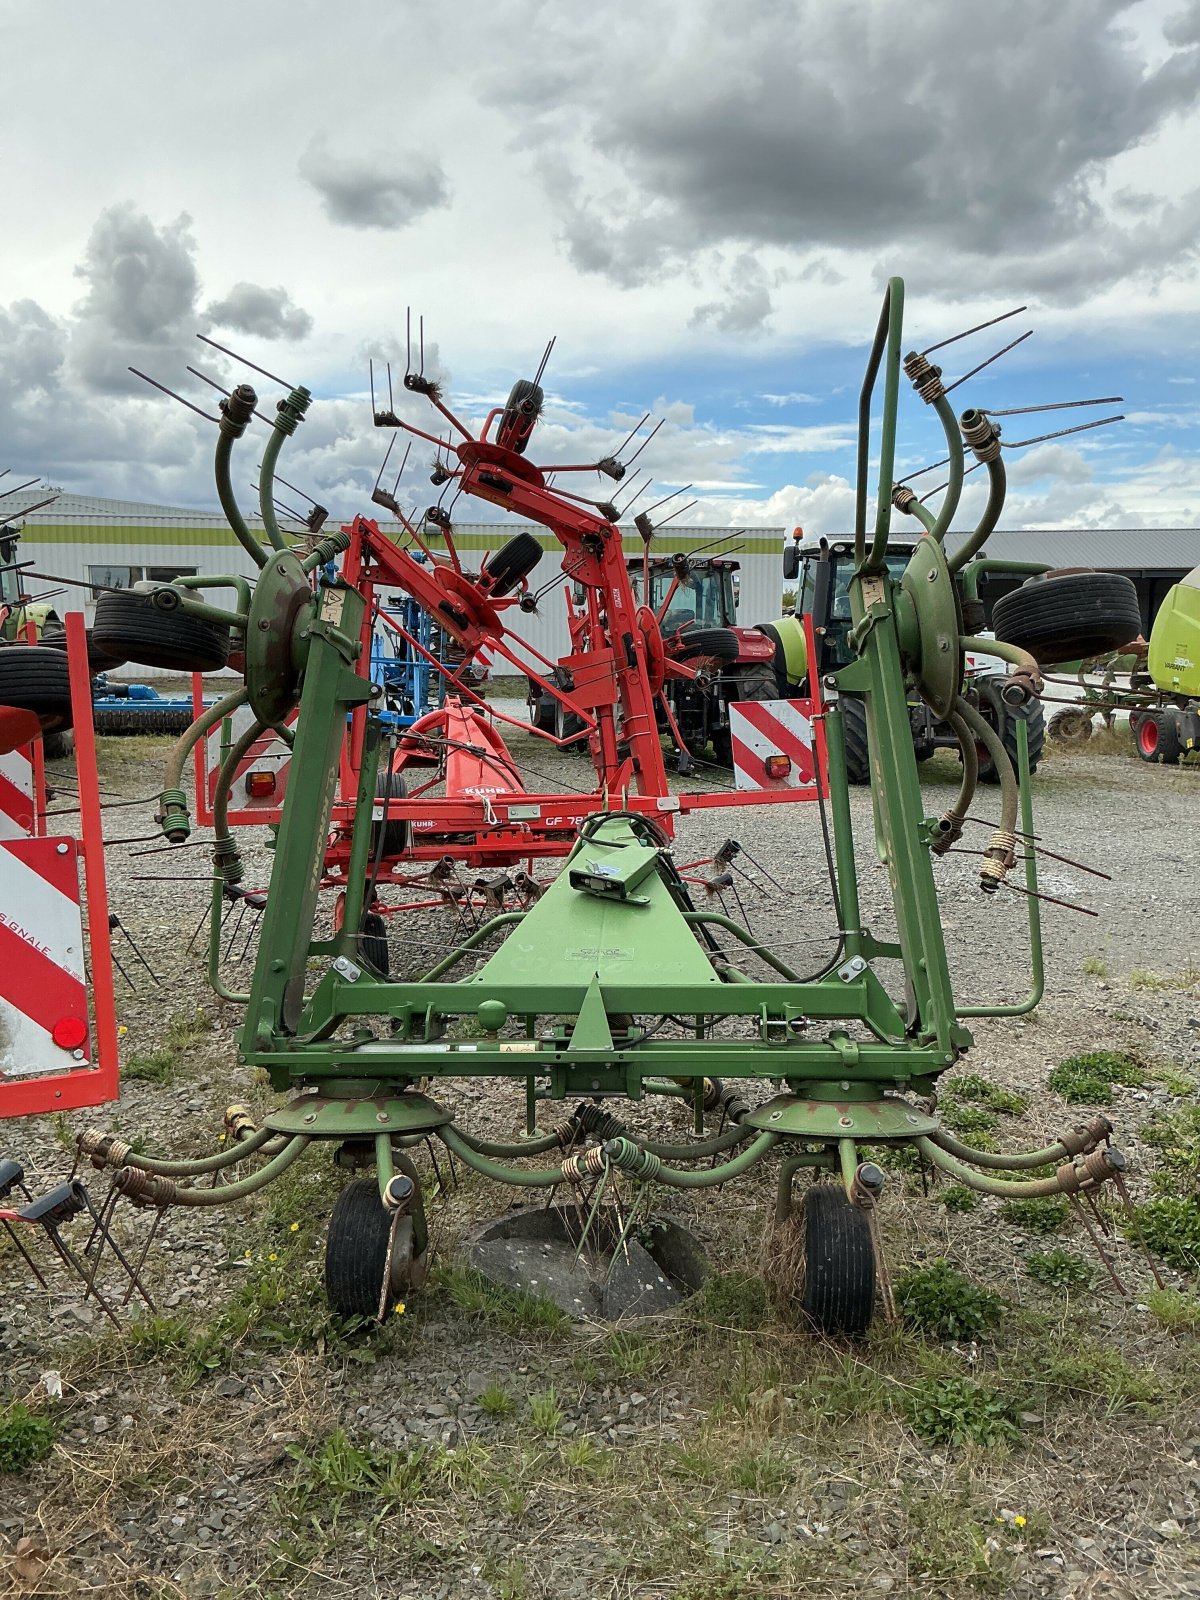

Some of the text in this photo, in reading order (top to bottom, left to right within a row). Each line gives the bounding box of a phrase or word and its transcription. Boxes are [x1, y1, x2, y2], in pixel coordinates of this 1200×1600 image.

[464, 786, 507, 795] KUHN
[410, 820, 433, 828] KUHN
[545, 817, 563, 826] GF
[310, 795, 329, 893] KRONE
